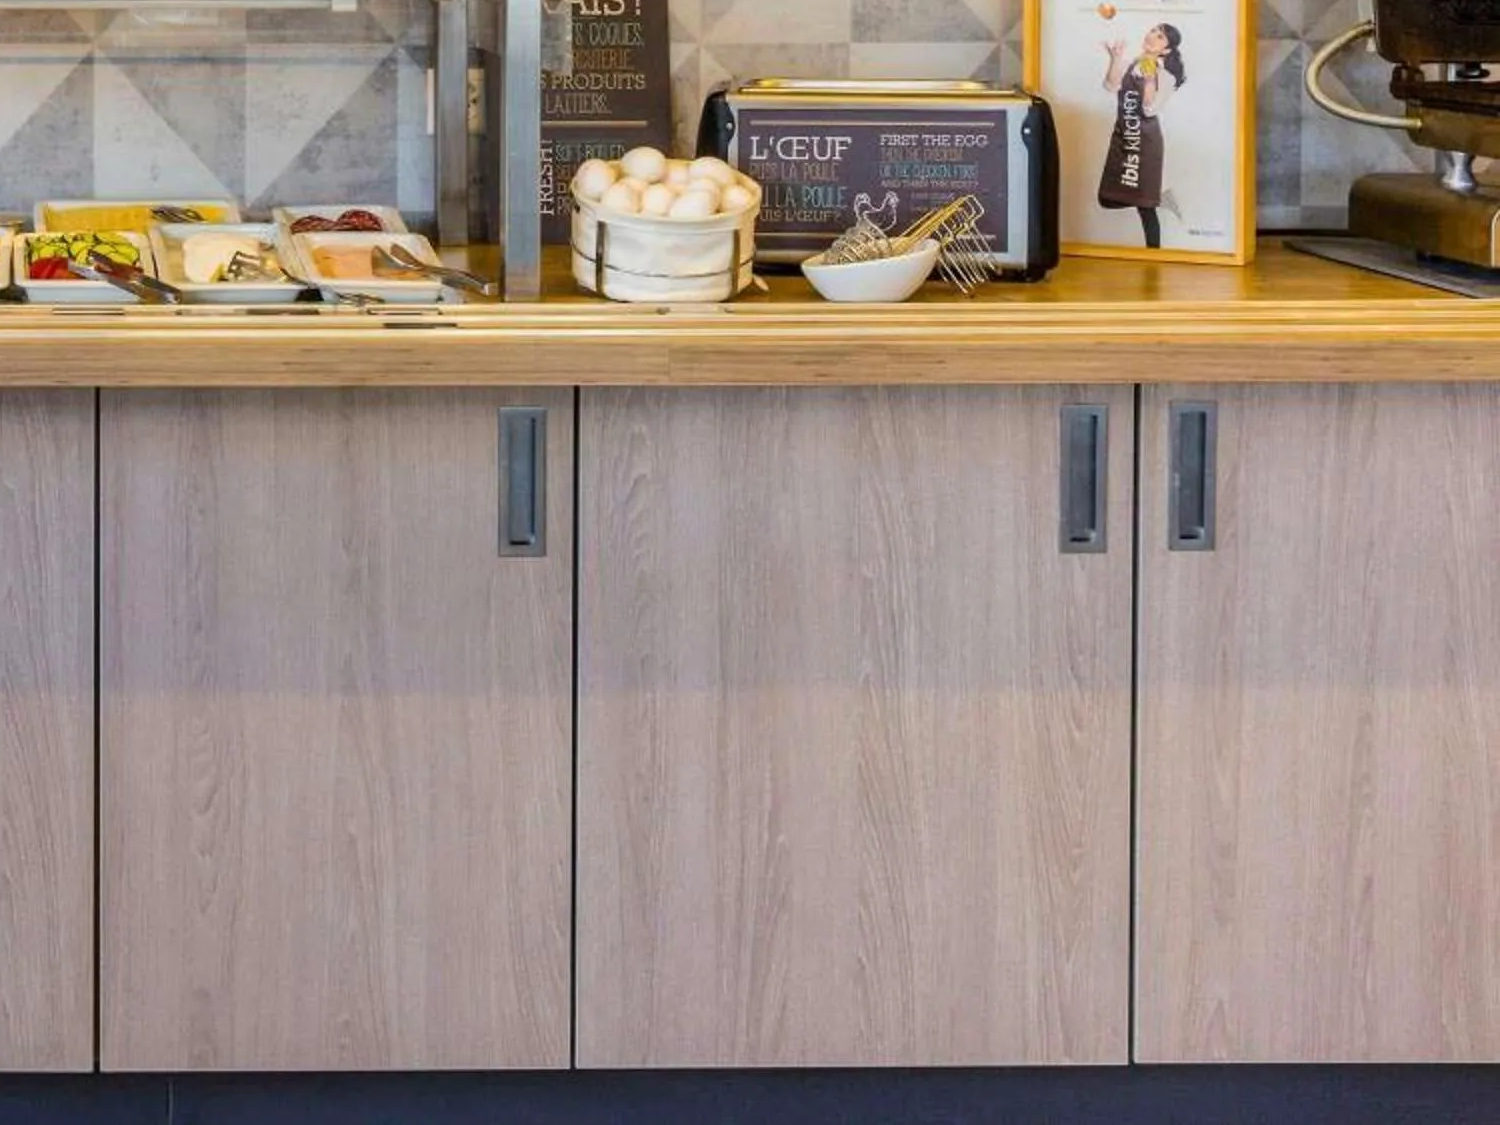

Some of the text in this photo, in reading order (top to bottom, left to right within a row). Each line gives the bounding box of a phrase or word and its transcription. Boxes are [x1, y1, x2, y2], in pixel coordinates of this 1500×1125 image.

[552, 73, 646, 90] PRODUITS
[921, 134, 952, 147] THE
[955, 134, 989, 148] EGG
[1121, 155, 1142, 187] ibis
